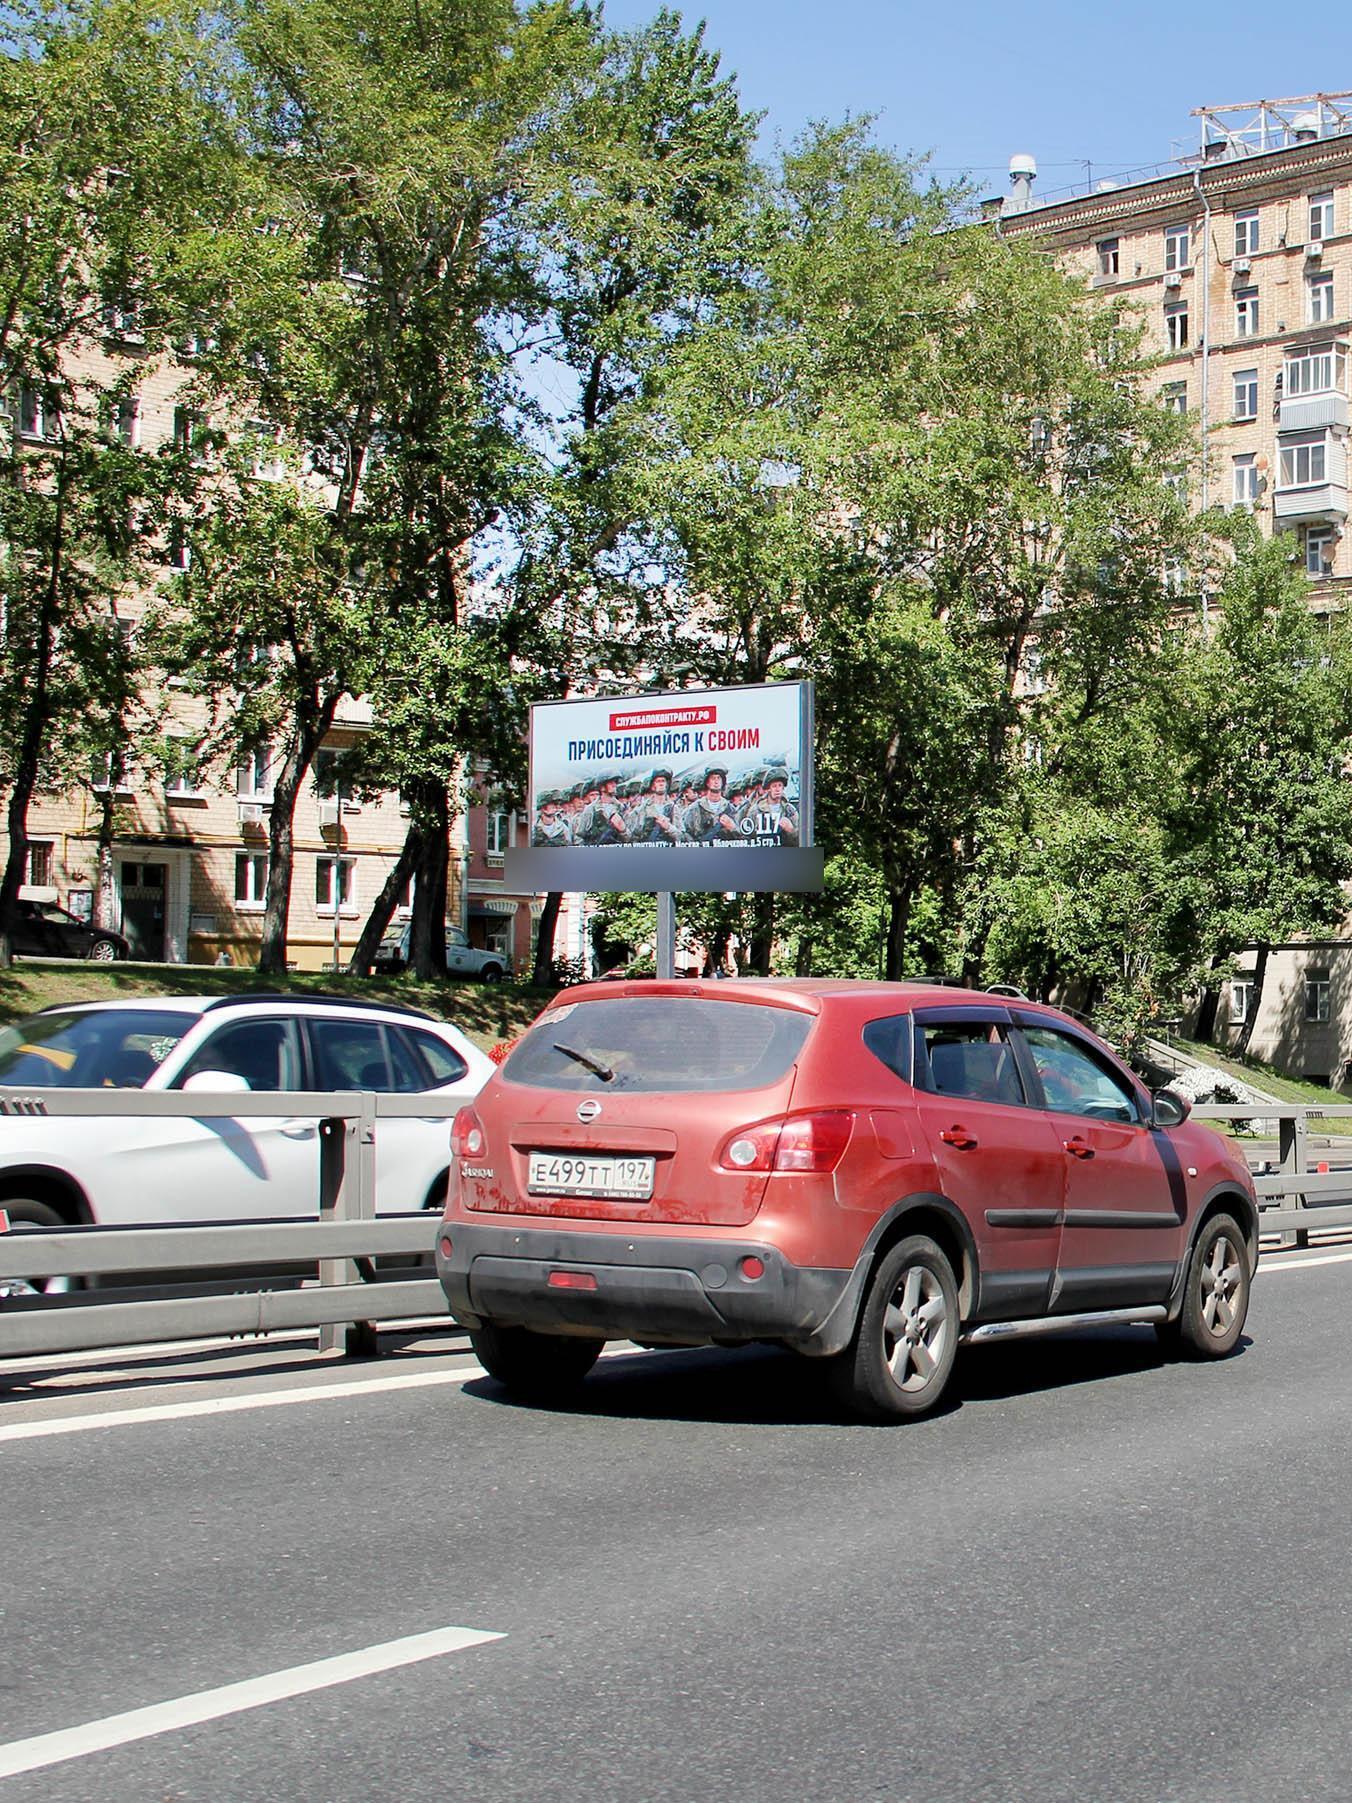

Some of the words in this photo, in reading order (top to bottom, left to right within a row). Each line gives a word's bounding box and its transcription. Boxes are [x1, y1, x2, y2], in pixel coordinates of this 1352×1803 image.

[615, 710, 710, 727] СЛУЖБАПОКОНТРАКТУ.РФ
[568, 730, 689, 761] ПРИСОЕДИНЯЙСЯ
[694, 732, 704, 752] К
[708, 728, 760, 751] СВОИМ
[756, 812, 781, 834] 117
[536, 1159, 611, 1184] Е499ТТ
[618, 1161, 646, 1180] 197
